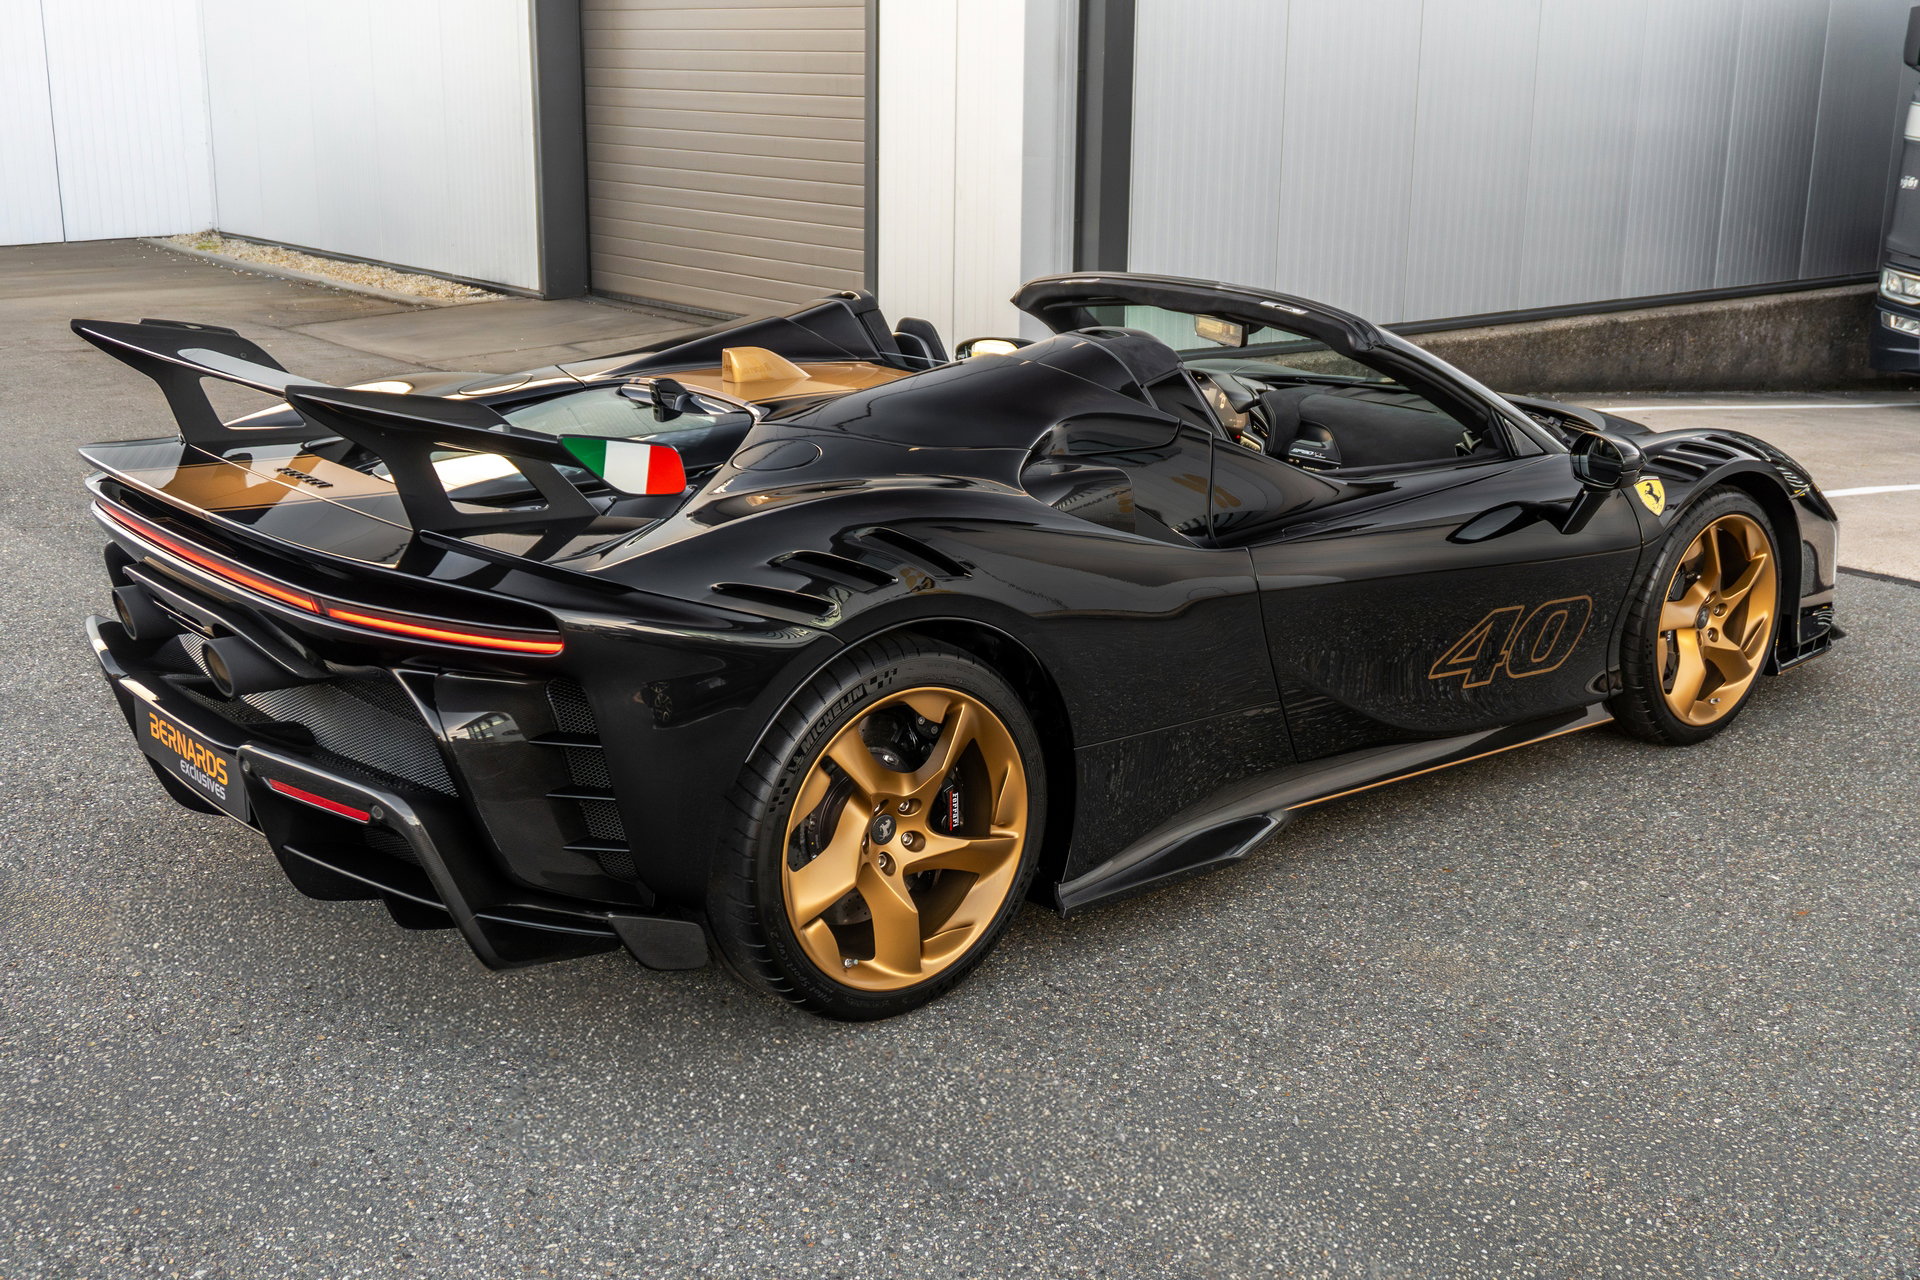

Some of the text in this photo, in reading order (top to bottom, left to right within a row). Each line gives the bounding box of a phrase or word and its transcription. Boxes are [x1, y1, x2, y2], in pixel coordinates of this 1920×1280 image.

[1428, 595, 1592, 689] 40
[148, 711, 228, 785] BERNARDS
[800, 684, 864, 754] MICHELIN
[180, 759, 226, 800] exclusives
